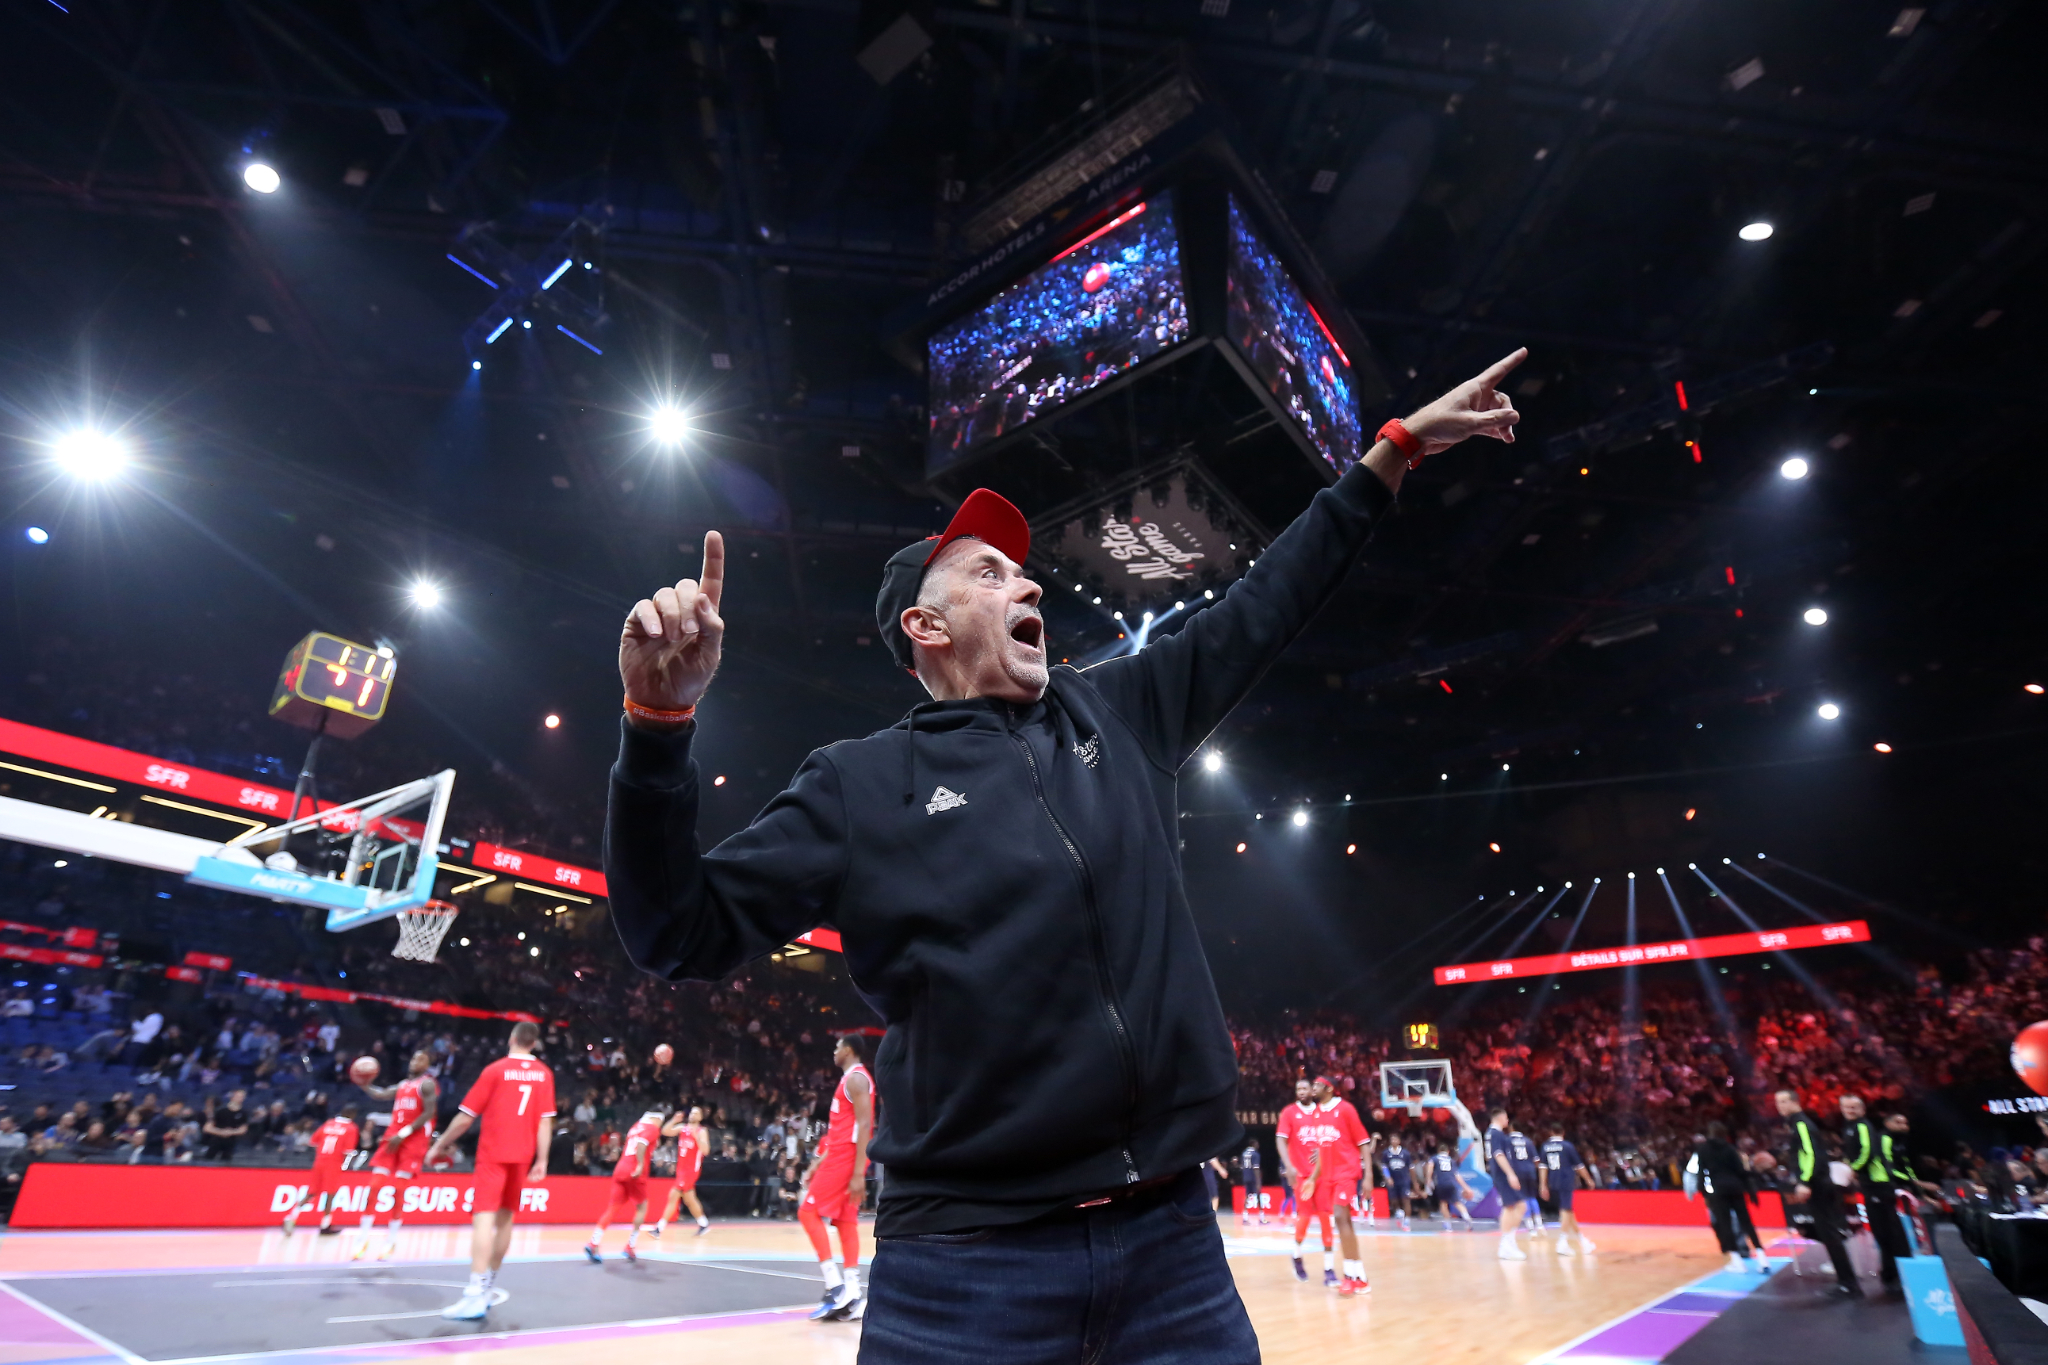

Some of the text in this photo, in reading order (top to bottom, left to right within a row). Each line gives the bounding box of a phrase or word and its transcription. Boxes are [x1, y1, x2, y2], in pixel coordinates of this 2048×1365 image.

[1086, 153, 1152, 203] ARENA
[144, 764, 190, 789] SFR
[238, 787, 279, 811] SFR
[493, 852, 523, 871] SFR
[554, 867, 582, 886] SFR
[1444, 968, 1466, 981] SFR
[1491, 963, 1513, 976] SFR
[1618, 949, 1644, 962] SUR
[1759, 933, 1788, 947] SFR
[517, 1084, 533, 1116] 7
[402, 1186, 459, 1212] SUR
